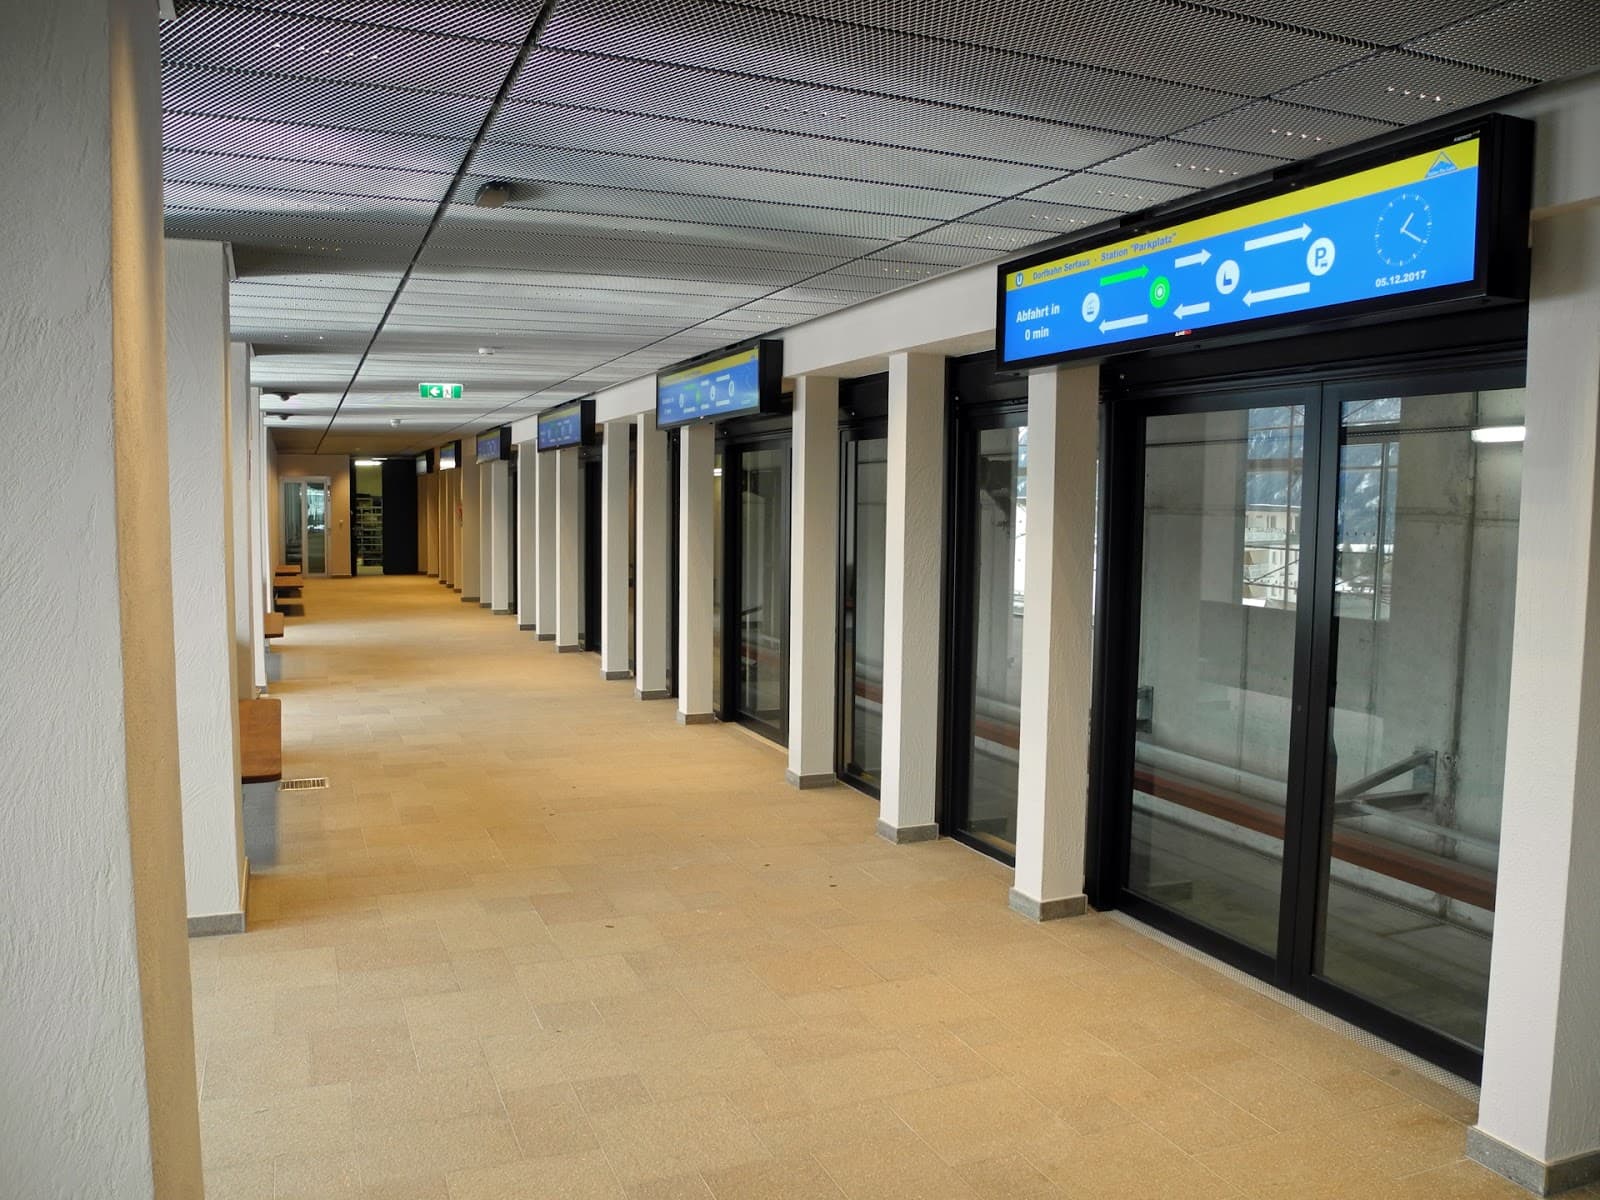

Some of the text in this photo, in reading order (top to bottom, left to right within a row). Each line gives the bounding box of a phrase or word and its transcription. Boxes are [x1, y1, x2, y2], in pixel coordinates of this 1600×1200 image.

[1033, 265, 1062, 280] Dorfbahn
[1101, 248, 1128, 261] Station
[1314, 247, 1327, 267] P
[1375, 270, 1427, 288] 05.12.2017
[1016, 303, 1060, 323] Abfahrt in
[1024, 327, 1049, 341] 0 min
